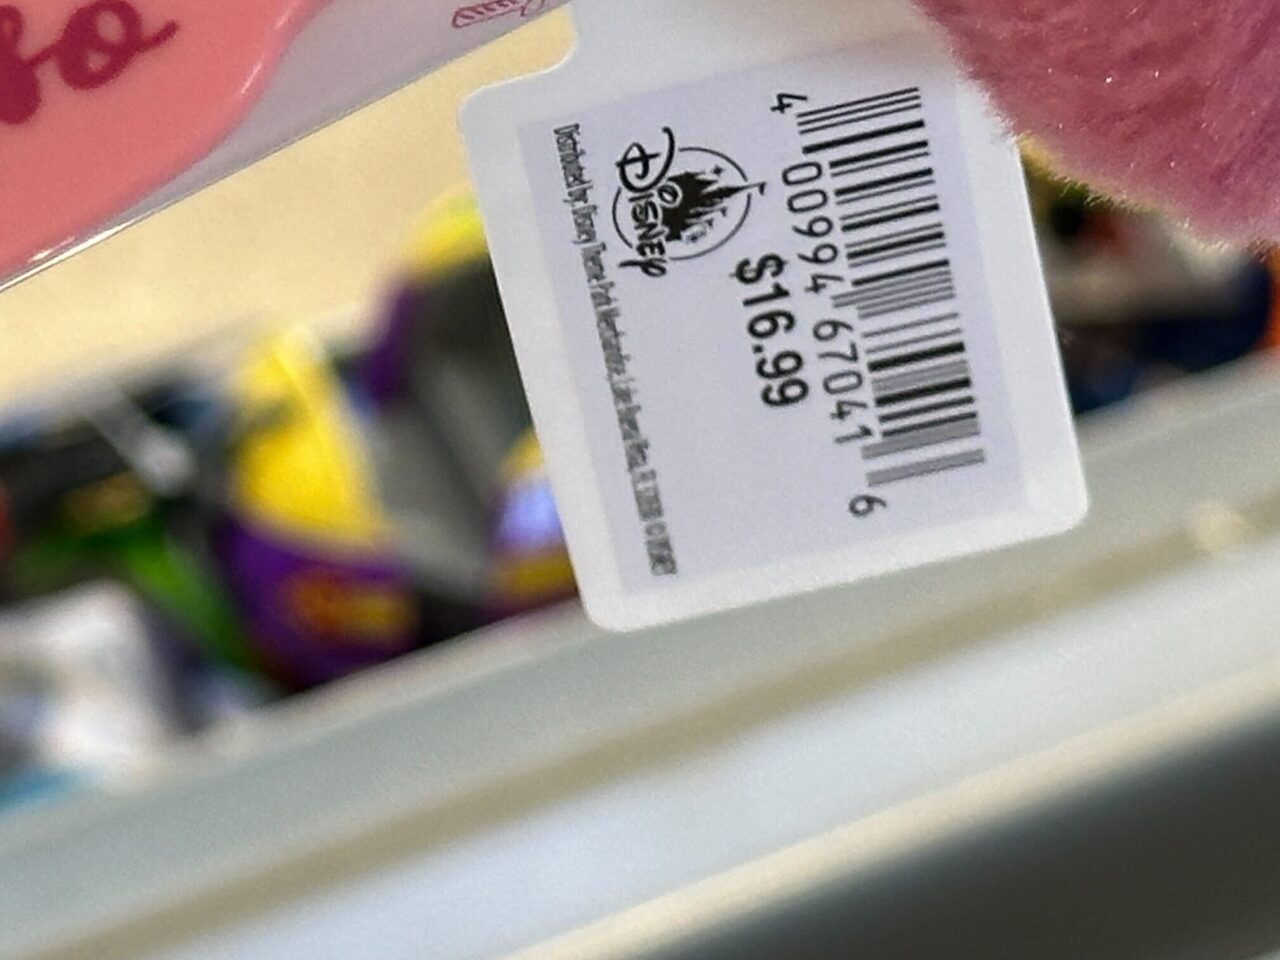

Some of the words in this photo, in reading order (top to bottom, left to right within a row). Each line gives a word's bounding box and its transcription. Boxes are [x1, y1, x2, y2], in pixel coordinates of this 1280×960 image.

[770, 92, 808, 115] 4
[782, 161, 843, 296] 00994
[729, 252, 810, 408] $16.99
[812, 318, 873, 444] 67041
[848, 493, 887, 519] 6
